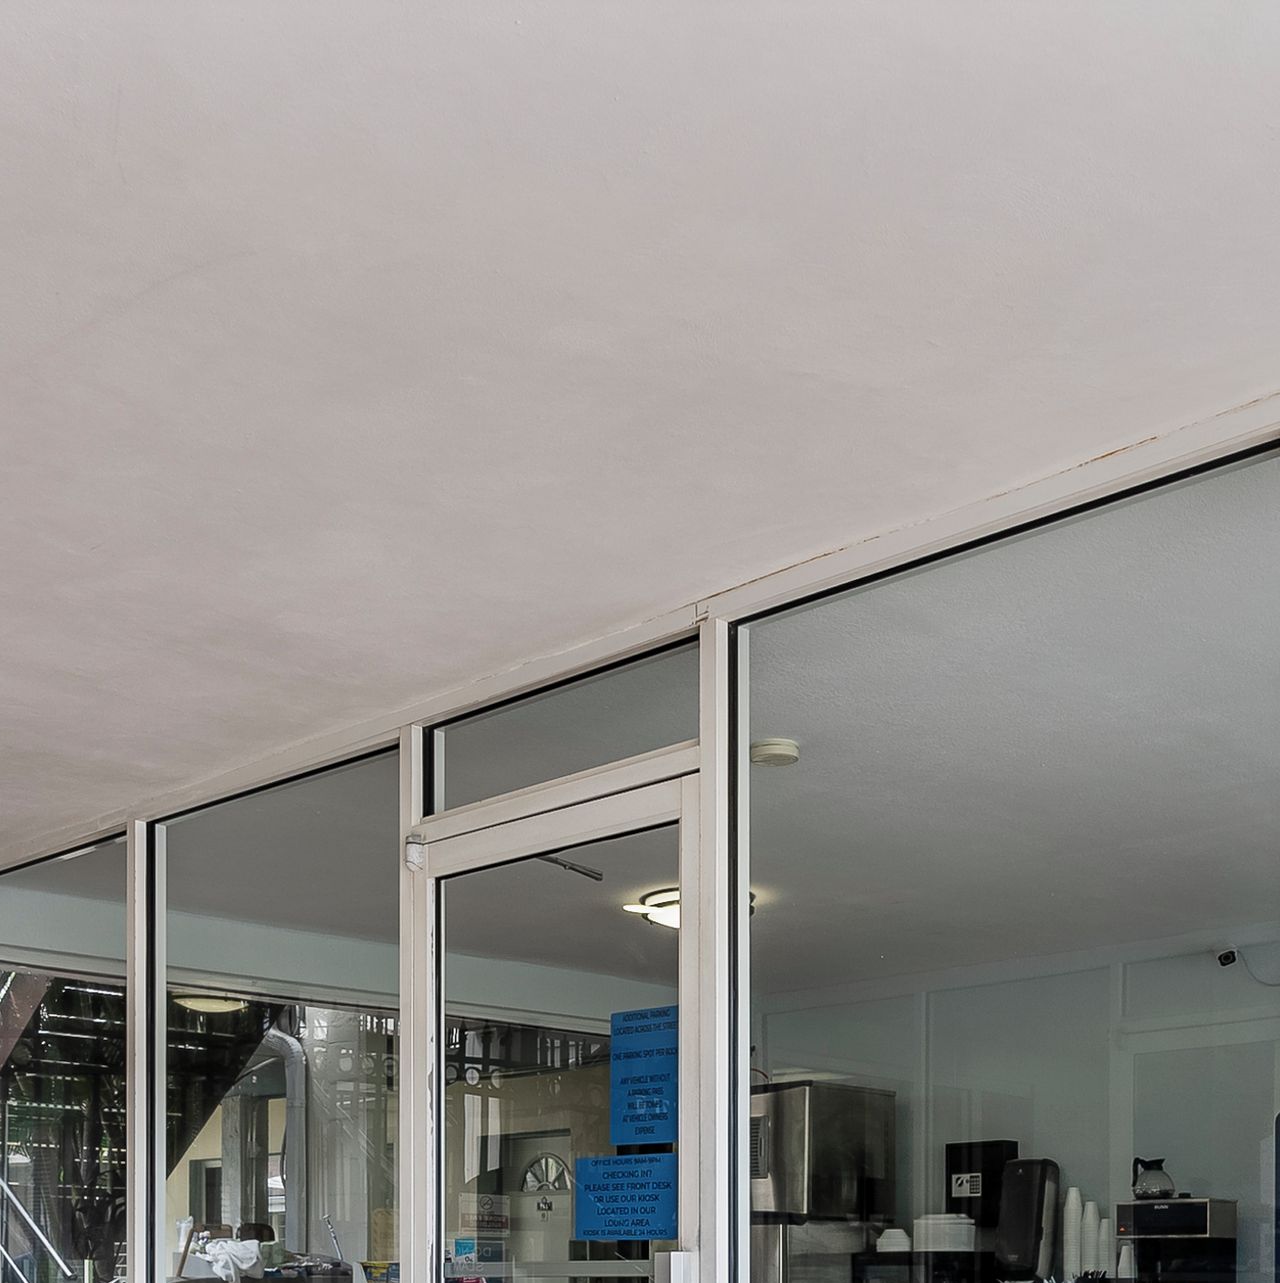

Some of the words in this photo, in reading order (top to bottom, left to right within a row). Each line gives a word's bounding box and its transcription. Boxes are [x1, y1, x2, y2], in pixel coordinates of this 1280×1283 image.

[602, 1170, 639, 1180] CHECKING
[584, 1183, 611, 1192] PLEASE
[612, 1182, 625, 1191] SEE
[626, 1181, 651, 1191] FRONT
[652, 1181, 673, 1190] DESK
[593, 1195, 605, 1204] OR
[605, 1195, 620, 1203] USE
[620, 1194, 637, 1203] OUR
[637, 1193, 661, 1202] KIOSK
[597, 1206, 630, 1216] LOCATED
[630, 1206, 639, 1215] IN
[639, 1206, 656, 1215] OUR
[630, 1217, 651, 1227] AREA
[646, 1228, 668, 1236] HOURS
